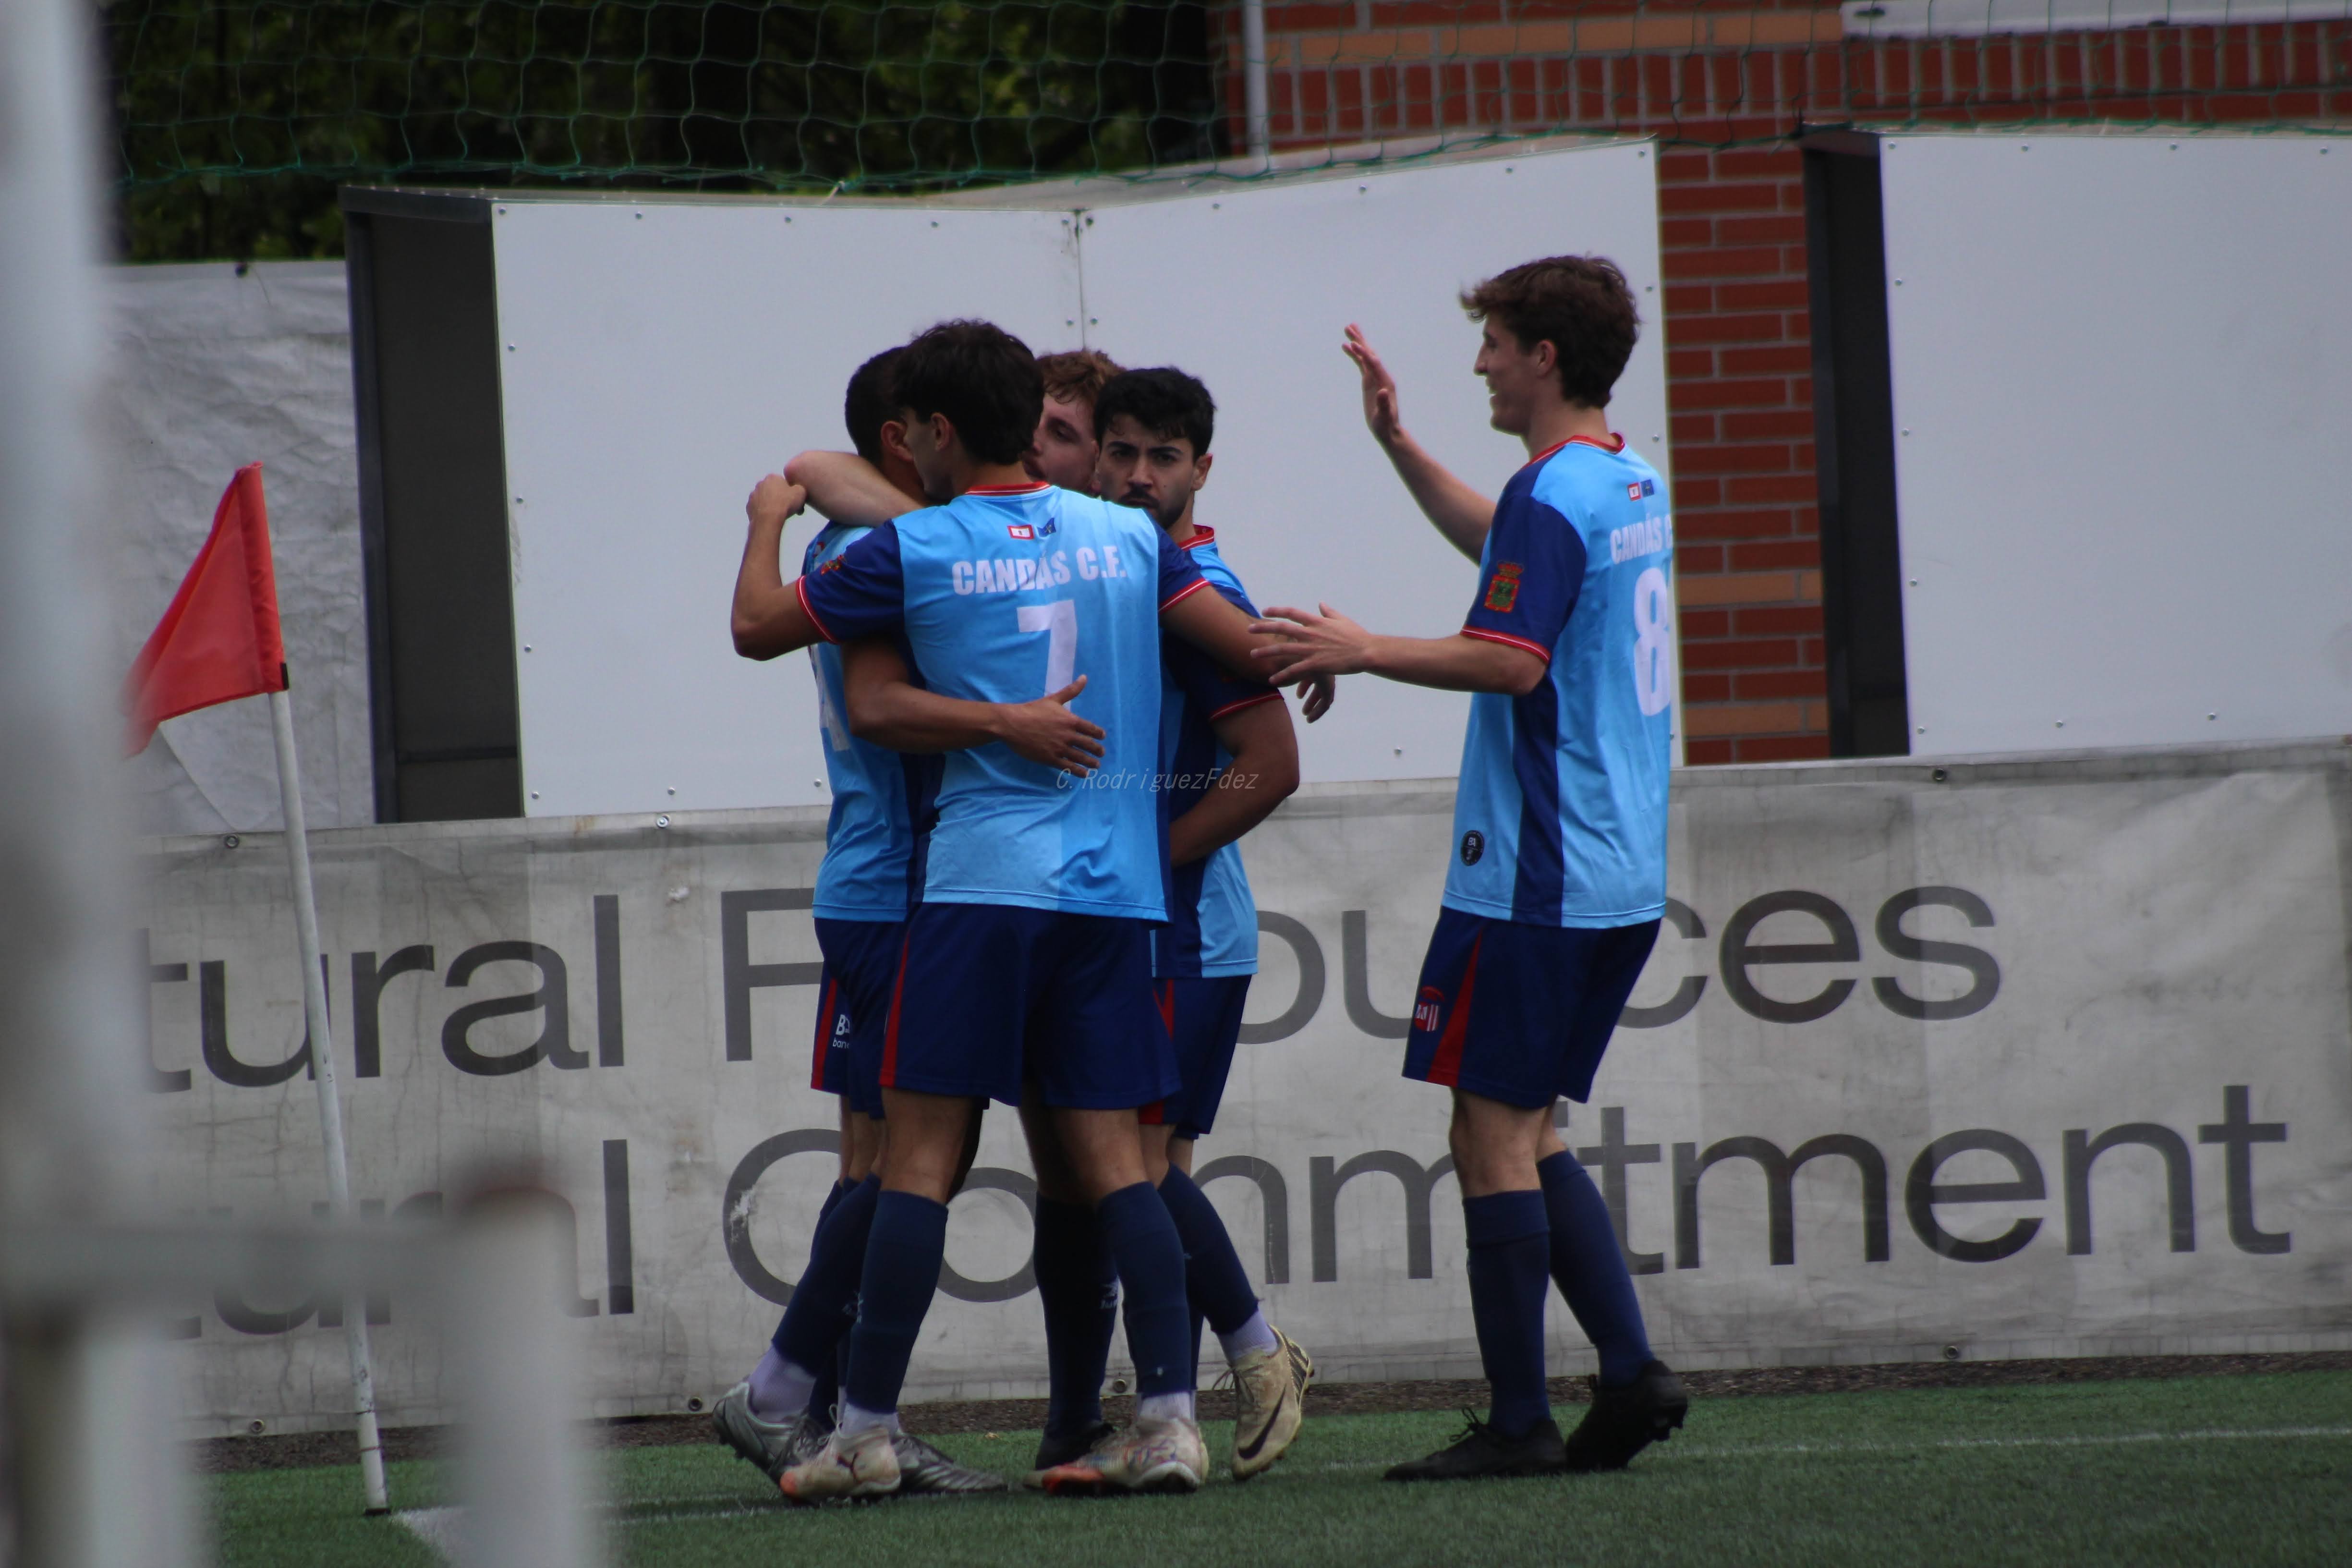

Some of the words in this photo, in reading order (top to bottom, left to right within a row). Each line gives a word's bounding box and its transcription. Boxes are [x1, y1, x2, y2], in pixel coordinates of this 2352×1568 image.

[1076, 545, 1127, 581] C.F.
[1017, 599, 1078, 709] 7
[1634, 567, 1671, 717] 8
[137, 895, 625, 1094] tural
